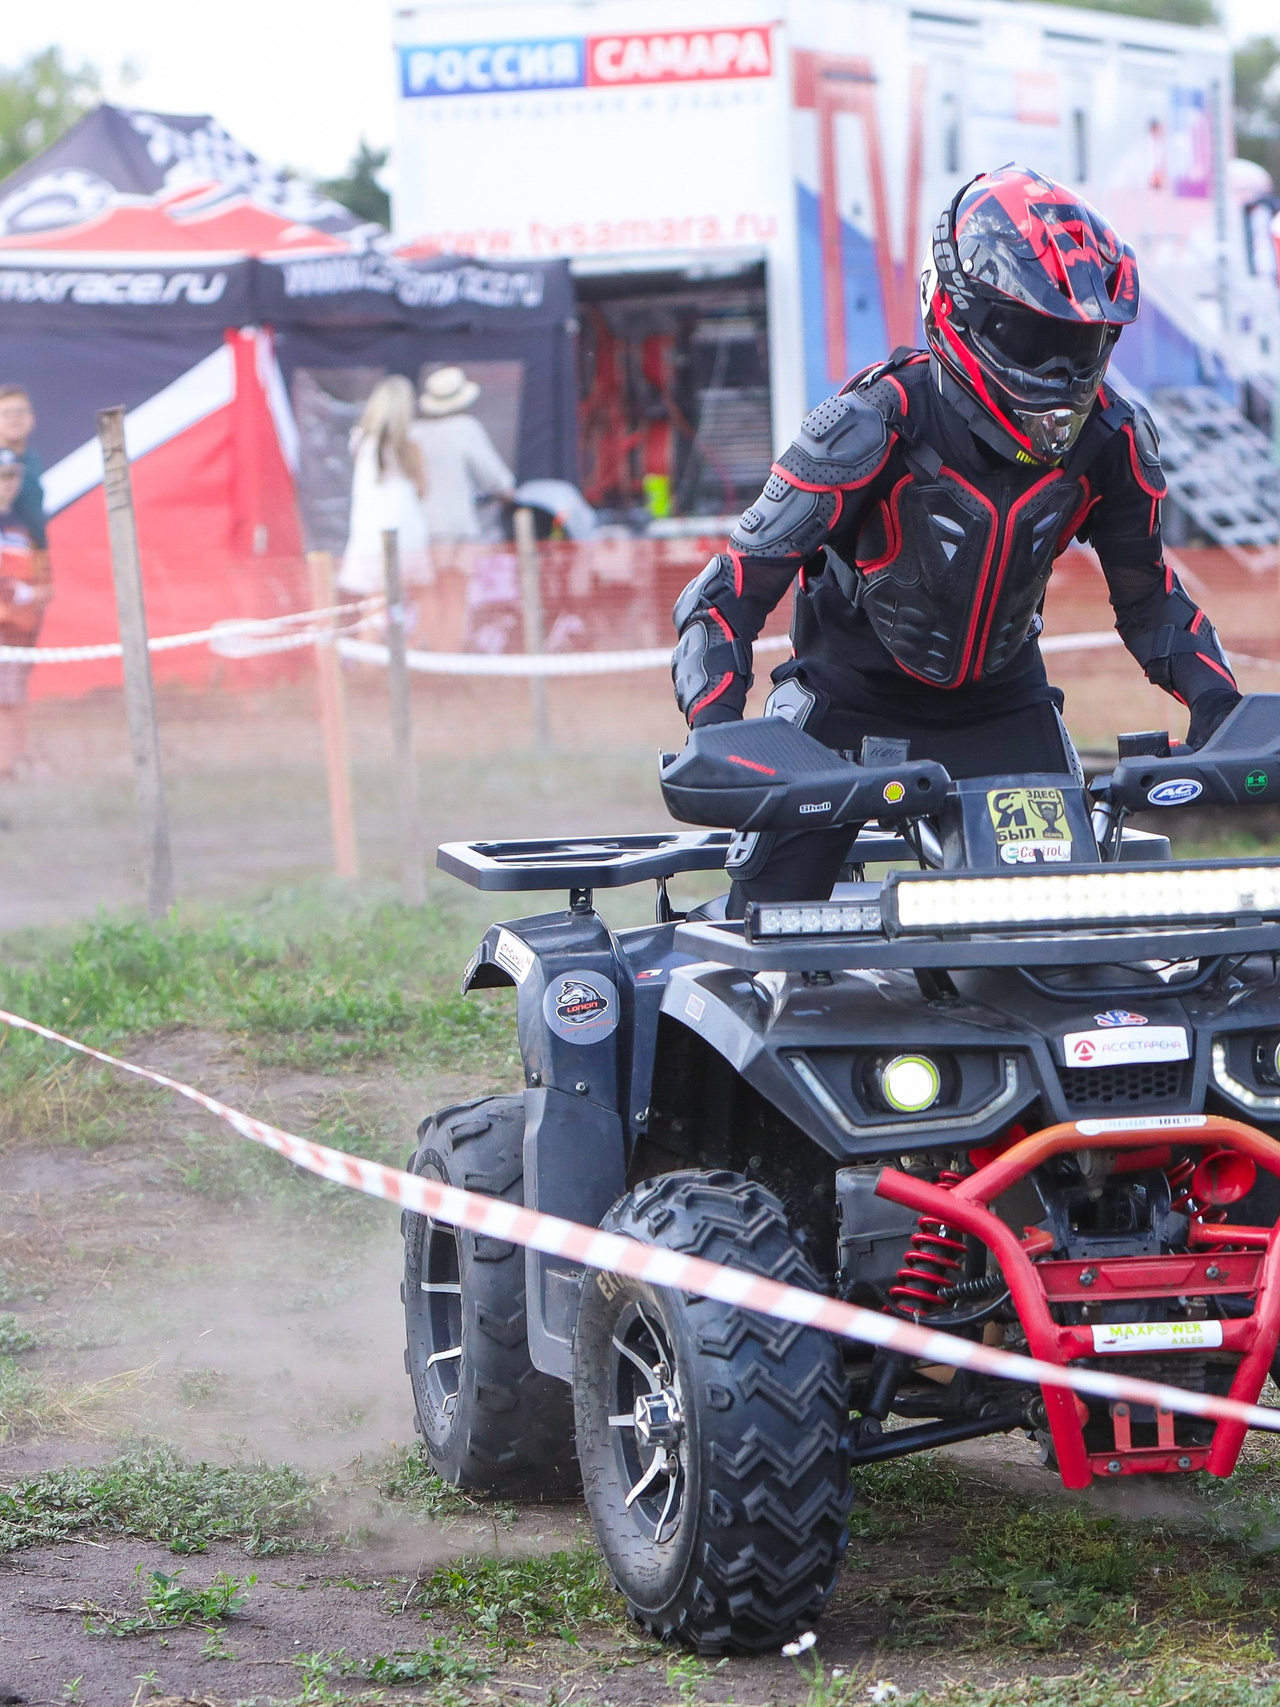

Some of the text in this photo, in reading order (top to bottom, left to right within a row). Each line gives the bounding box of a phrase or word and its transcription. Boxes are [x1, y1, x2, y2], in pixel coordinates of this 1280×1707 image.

[408, 31, 771, 92] РОССИЯ САМАРА
[801, 802, 831, 813] Shell
[996, 827, 1036, 841] БЫЛ
[1020, 845, 1063, 858] Catrol
[1171, 1336, 1205, 1345] AXLES
